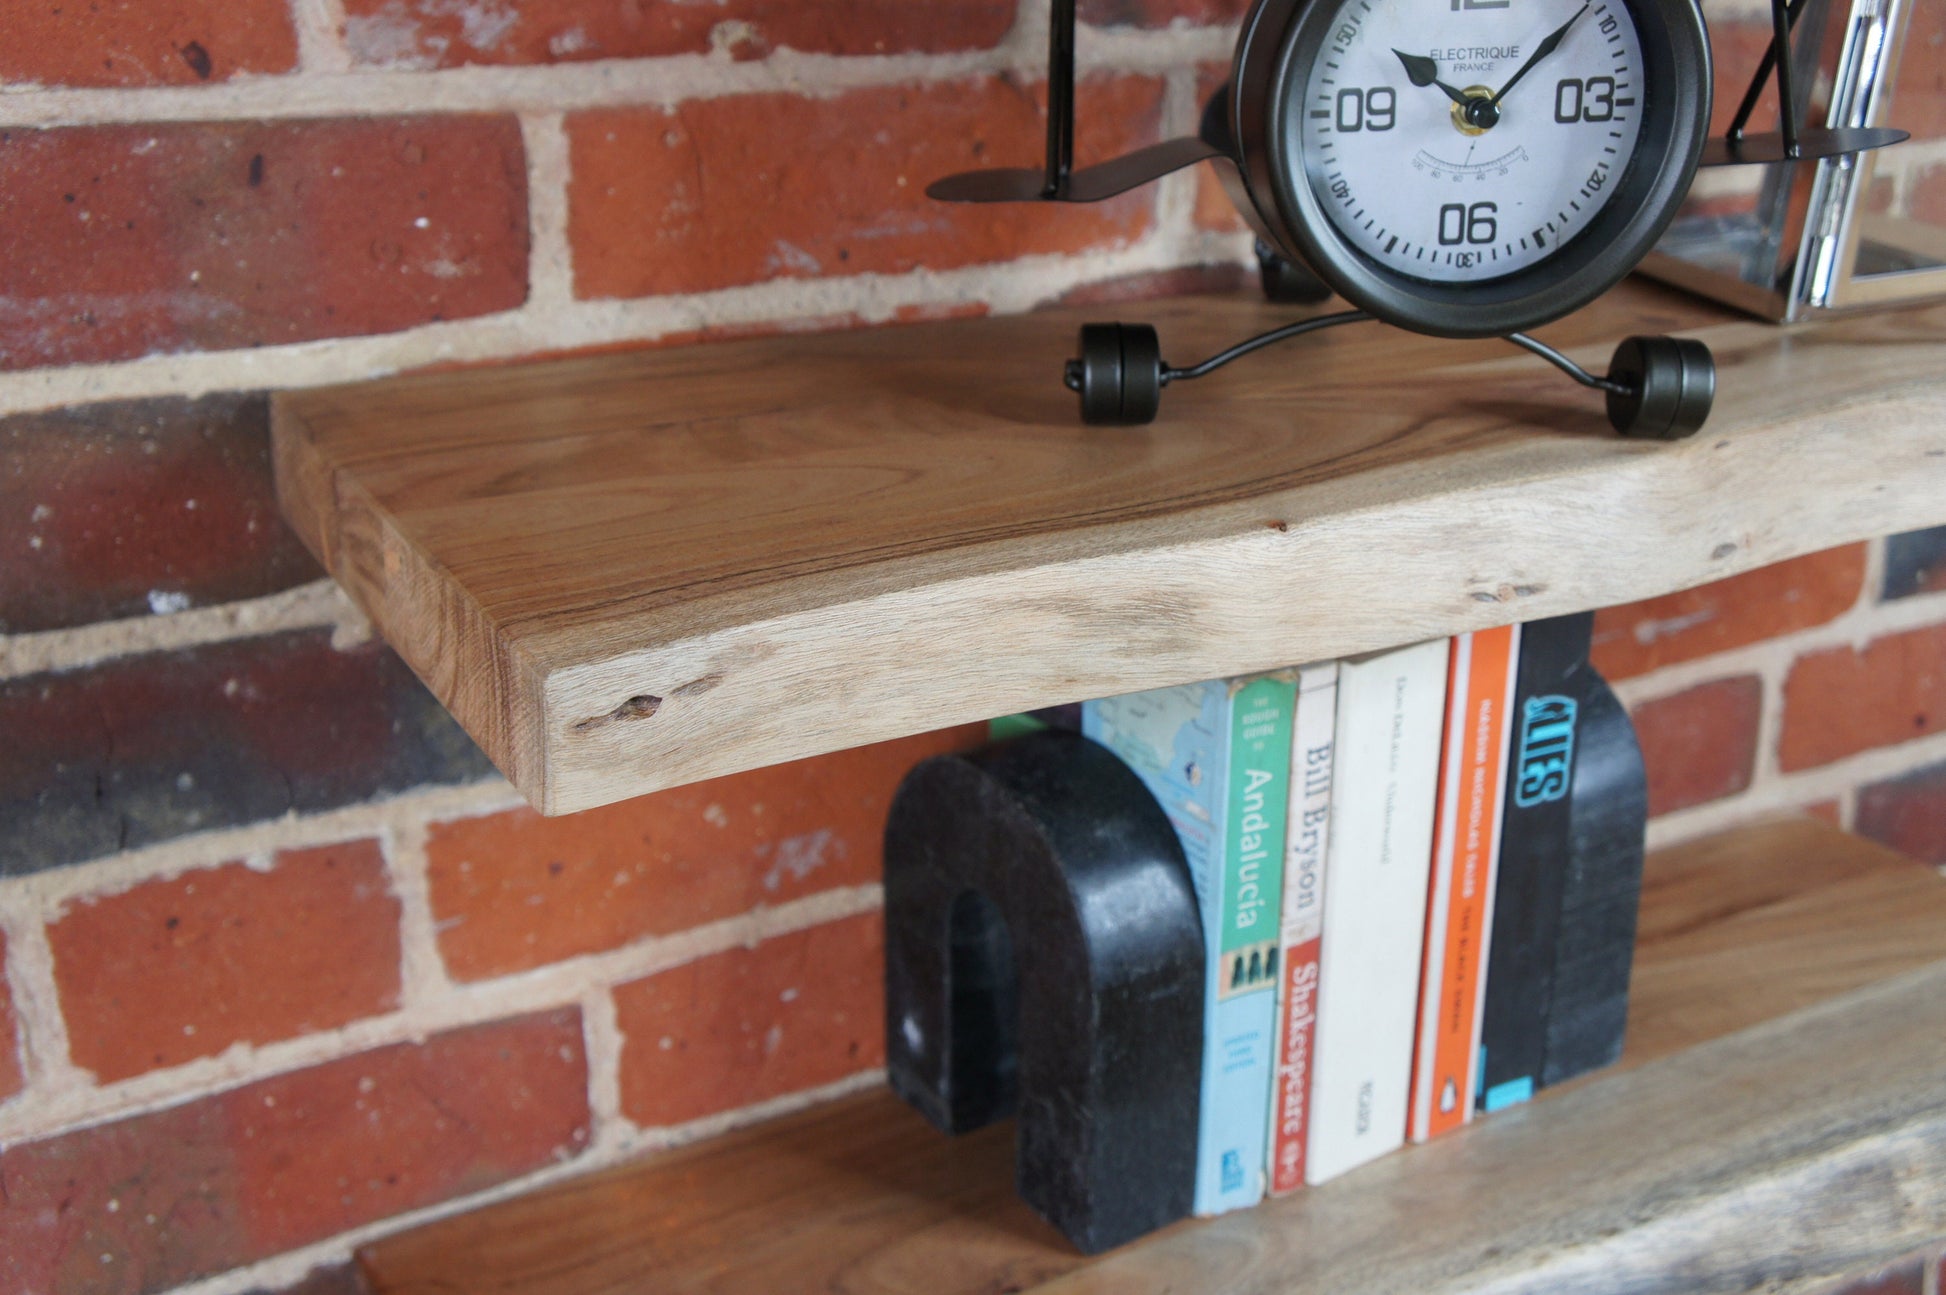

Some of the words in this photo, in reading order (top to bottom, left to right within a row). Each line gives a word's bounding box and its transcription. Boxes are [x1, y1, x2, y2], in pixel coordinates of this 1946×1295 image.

[1336, 24, 1358, 46] 50
[1599, 14, 1617, 35] 10
[1430, 46, 1520, 62] ELECTRIQUE
[1453, 62, 1495, 72] FRANCE
[1336, 86, 1396, 132] 09
[1554, 76, 1615, 123] 03
[1331, 179, 1350, 198] 40
[1586, 171, 1606, 191] 20
[1438, 201, 1498, 246] 06
[1455, 251, 1473, 268] 30
[1305, 743, 1332, 800] Bill
[1235, 768, 1273, 929] Andalucia
[1295, 805, 1329, 909] Bryson
[1279, 960, 1318, 1136] Shakespeare
